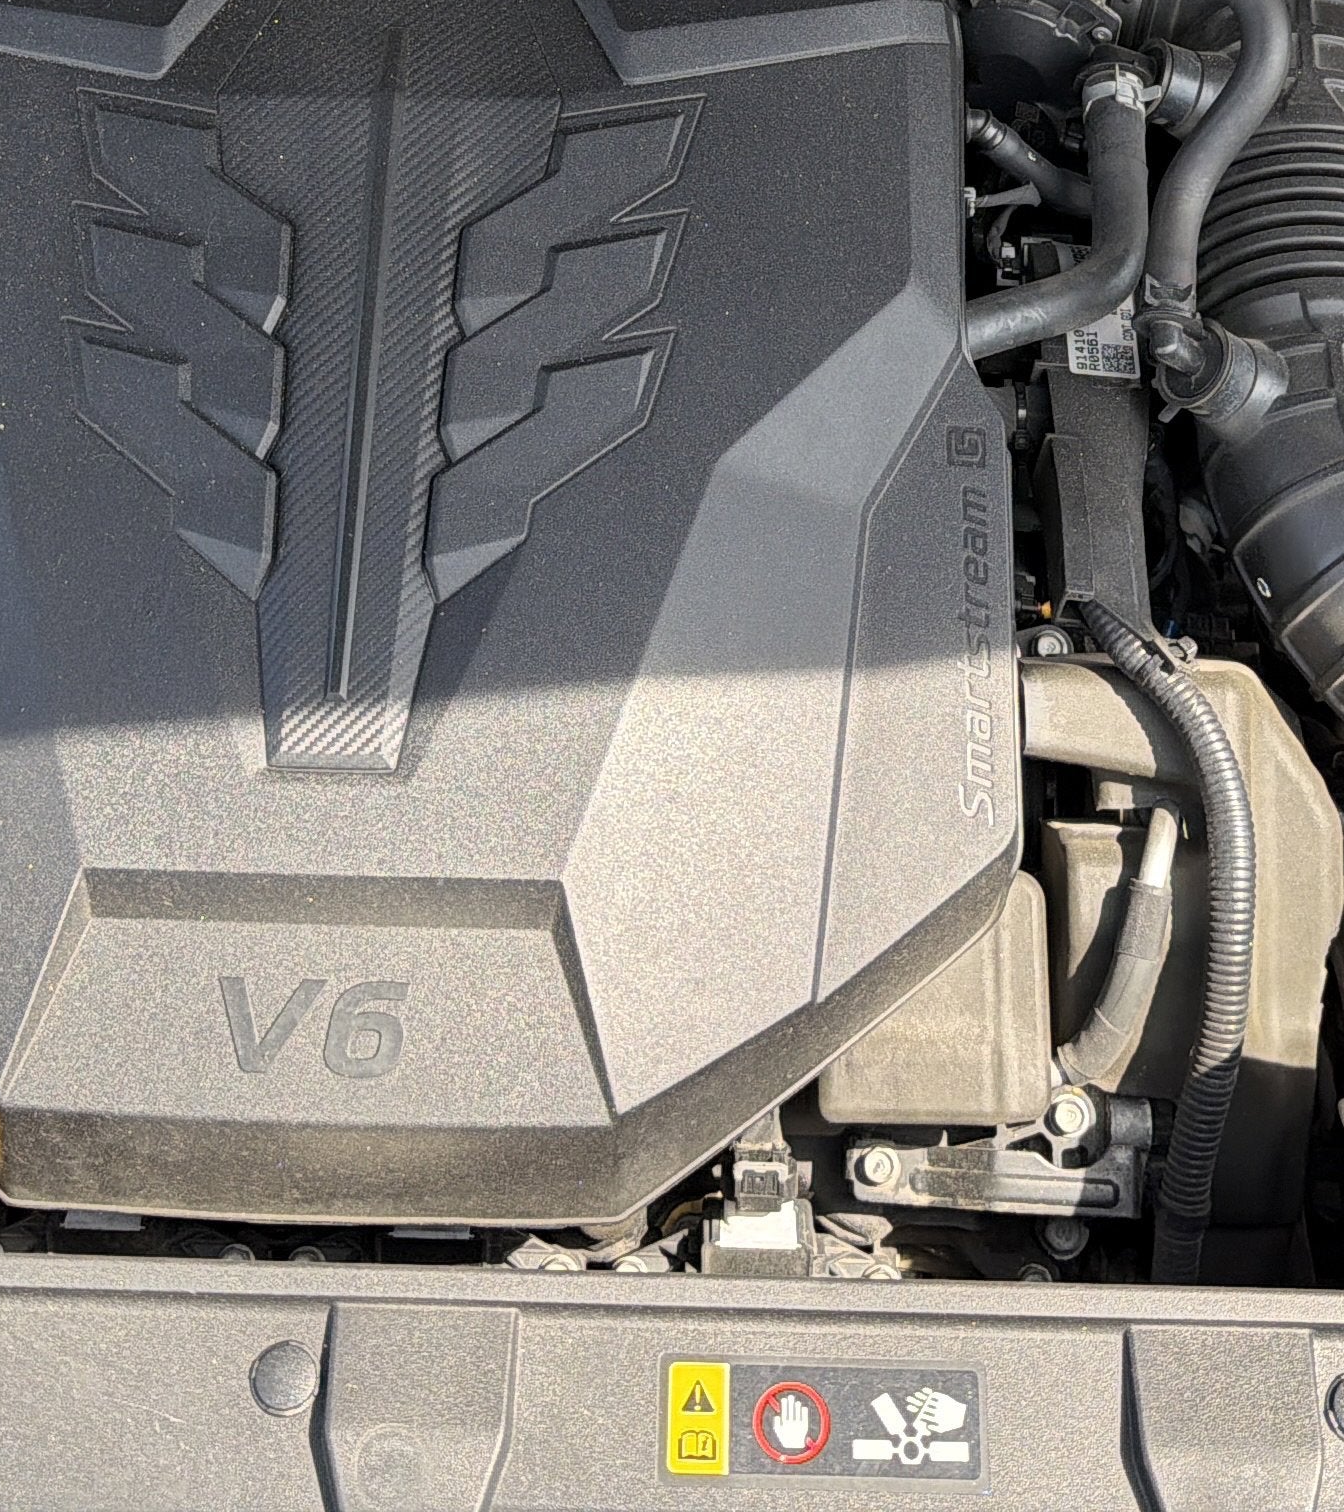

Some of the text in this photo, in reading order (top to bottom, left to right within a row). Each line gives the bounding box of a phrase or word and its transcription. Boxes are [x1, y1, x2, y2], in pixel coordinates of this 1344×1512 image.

[1074, 329, 1088, 370] 91410
[1086, 331, 1101, 372] R0561
[959, 485, 995, 827] Smartstream
[219, 976, 410, 1078] V6
